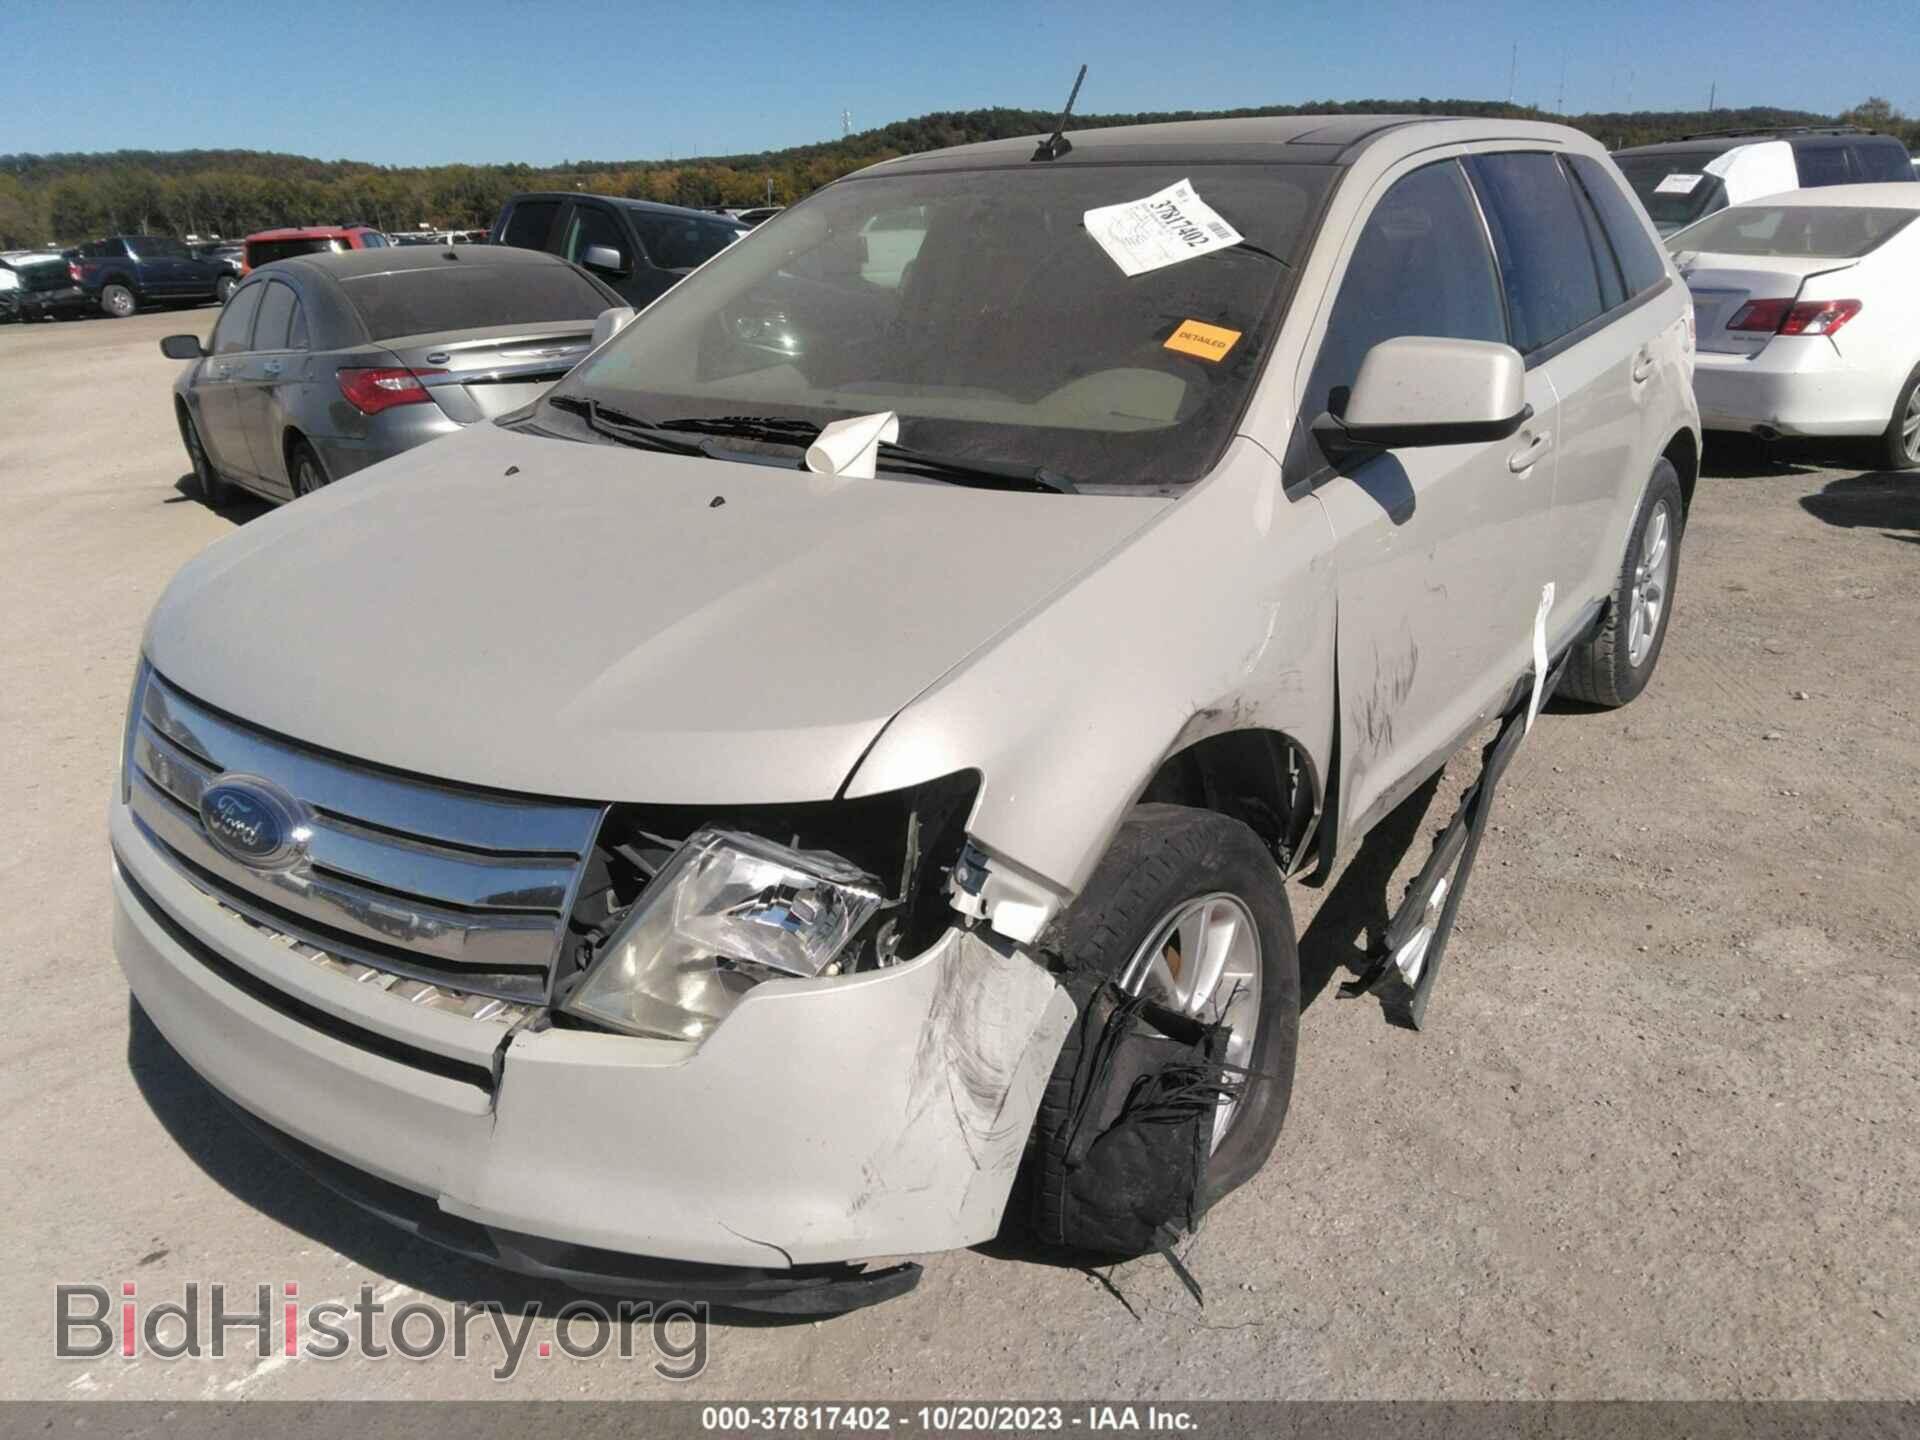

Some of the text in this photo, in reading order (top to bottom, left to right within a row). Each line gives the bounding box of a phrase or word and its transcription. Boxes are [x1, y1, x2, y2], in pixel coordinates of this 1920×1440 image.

[1149, 199, 1210, 247] 37817402
[1178, 331, 1227, 349] DETAILED
[210, 795, 263, 846] Ford
